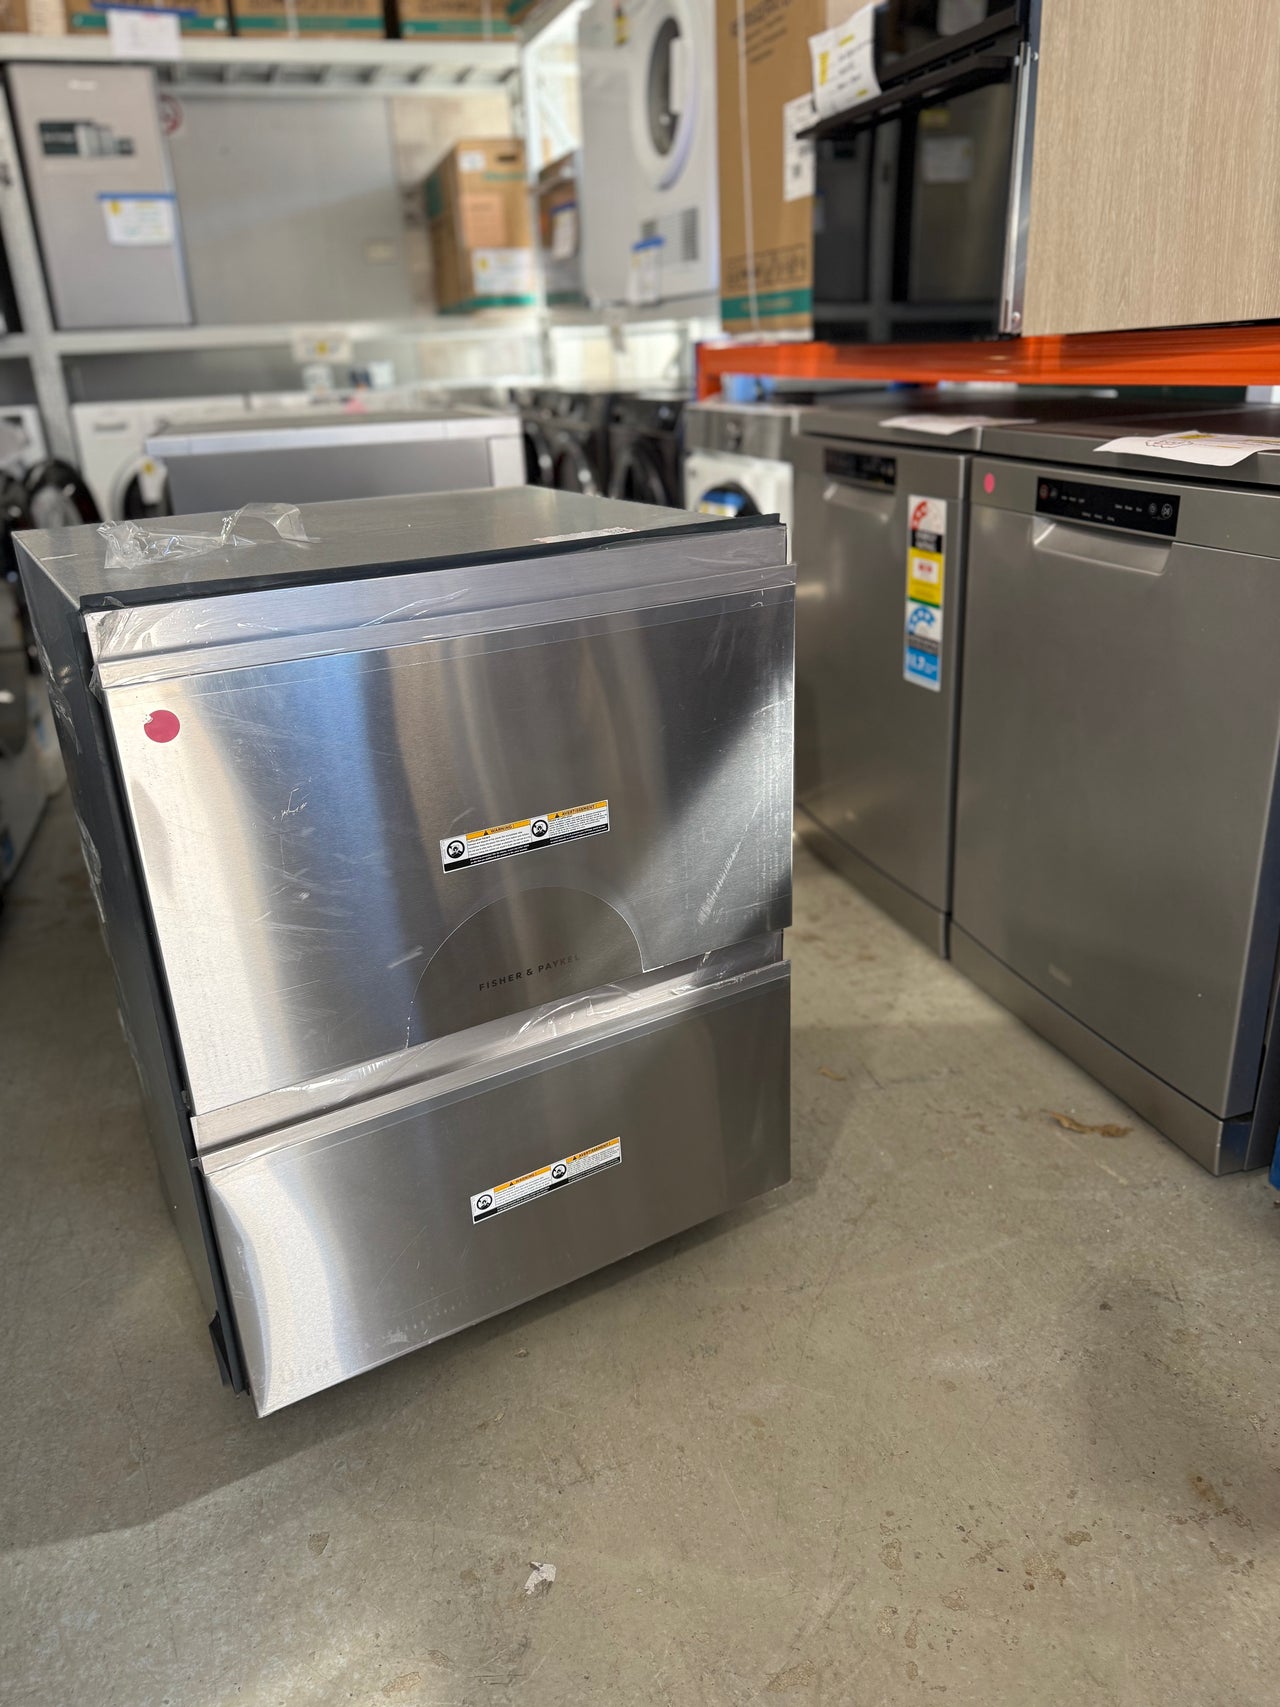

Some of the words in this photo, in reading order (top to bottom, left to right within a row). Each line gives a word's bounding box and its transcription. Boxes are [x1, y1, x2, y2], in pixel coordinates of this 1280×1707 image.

[490, 825, 513, 834] WARNING
[479, 972, 522, 991] FISHER
[526, 968, 533, 976] &
[538, 955, 579, 973] PAYKEL
